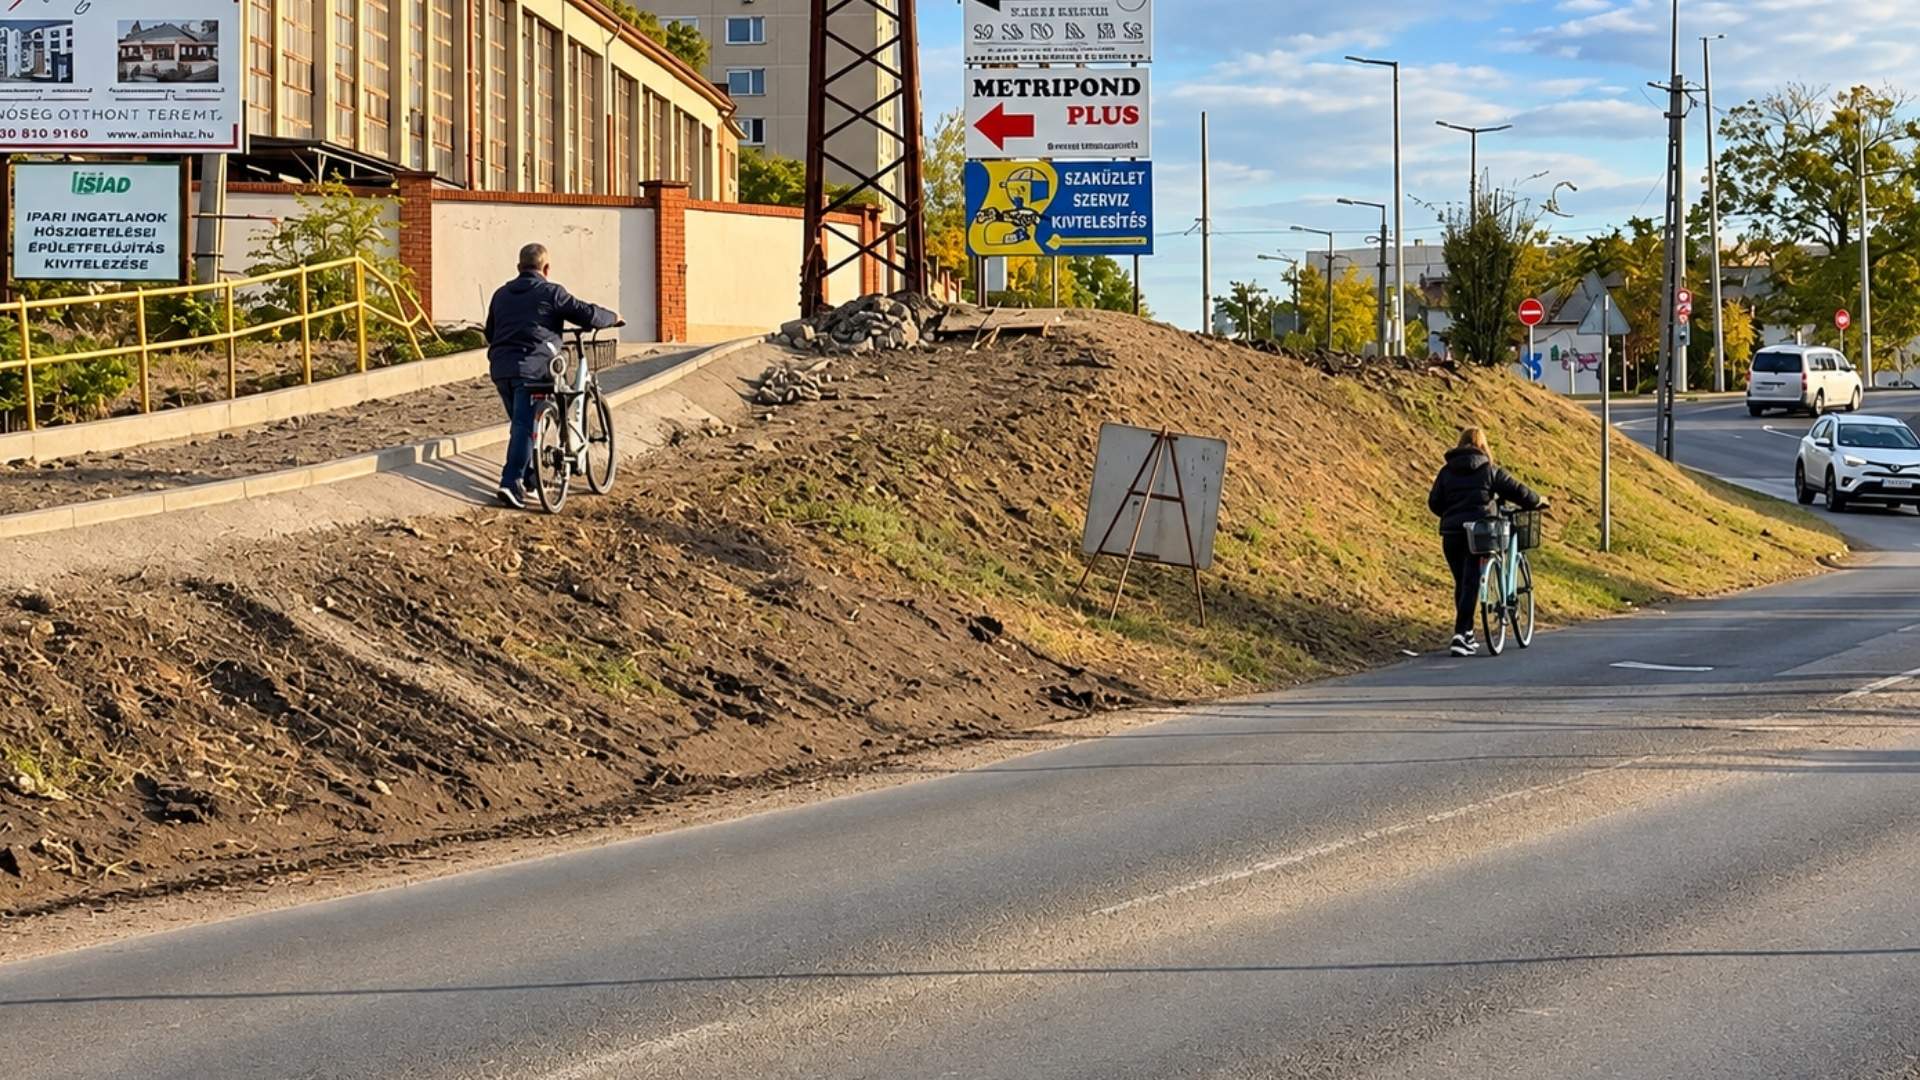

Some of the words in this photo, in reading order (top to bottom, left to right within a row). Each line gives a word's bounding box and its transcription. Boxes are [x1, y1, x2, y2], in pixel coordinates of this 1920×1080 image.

[973, 77, 1141, 97] METRIPOND
[58, 108, 139, 120] OTTHONT
[1067, 105, 1139, 125] PLUS
[21, 128, 48, 138] 810
[53, 128, 88, 138] 9160
[1064, 169, 1145, 186] SZAKÜZLET
[1073, 193, 1129, 207] SZERVIZ
[27, 212, 66, 222] IPARI
[71, 212, 167, 223] INGATLANOK
[44, 255, 149, 270] KIVITELEZÉSE
